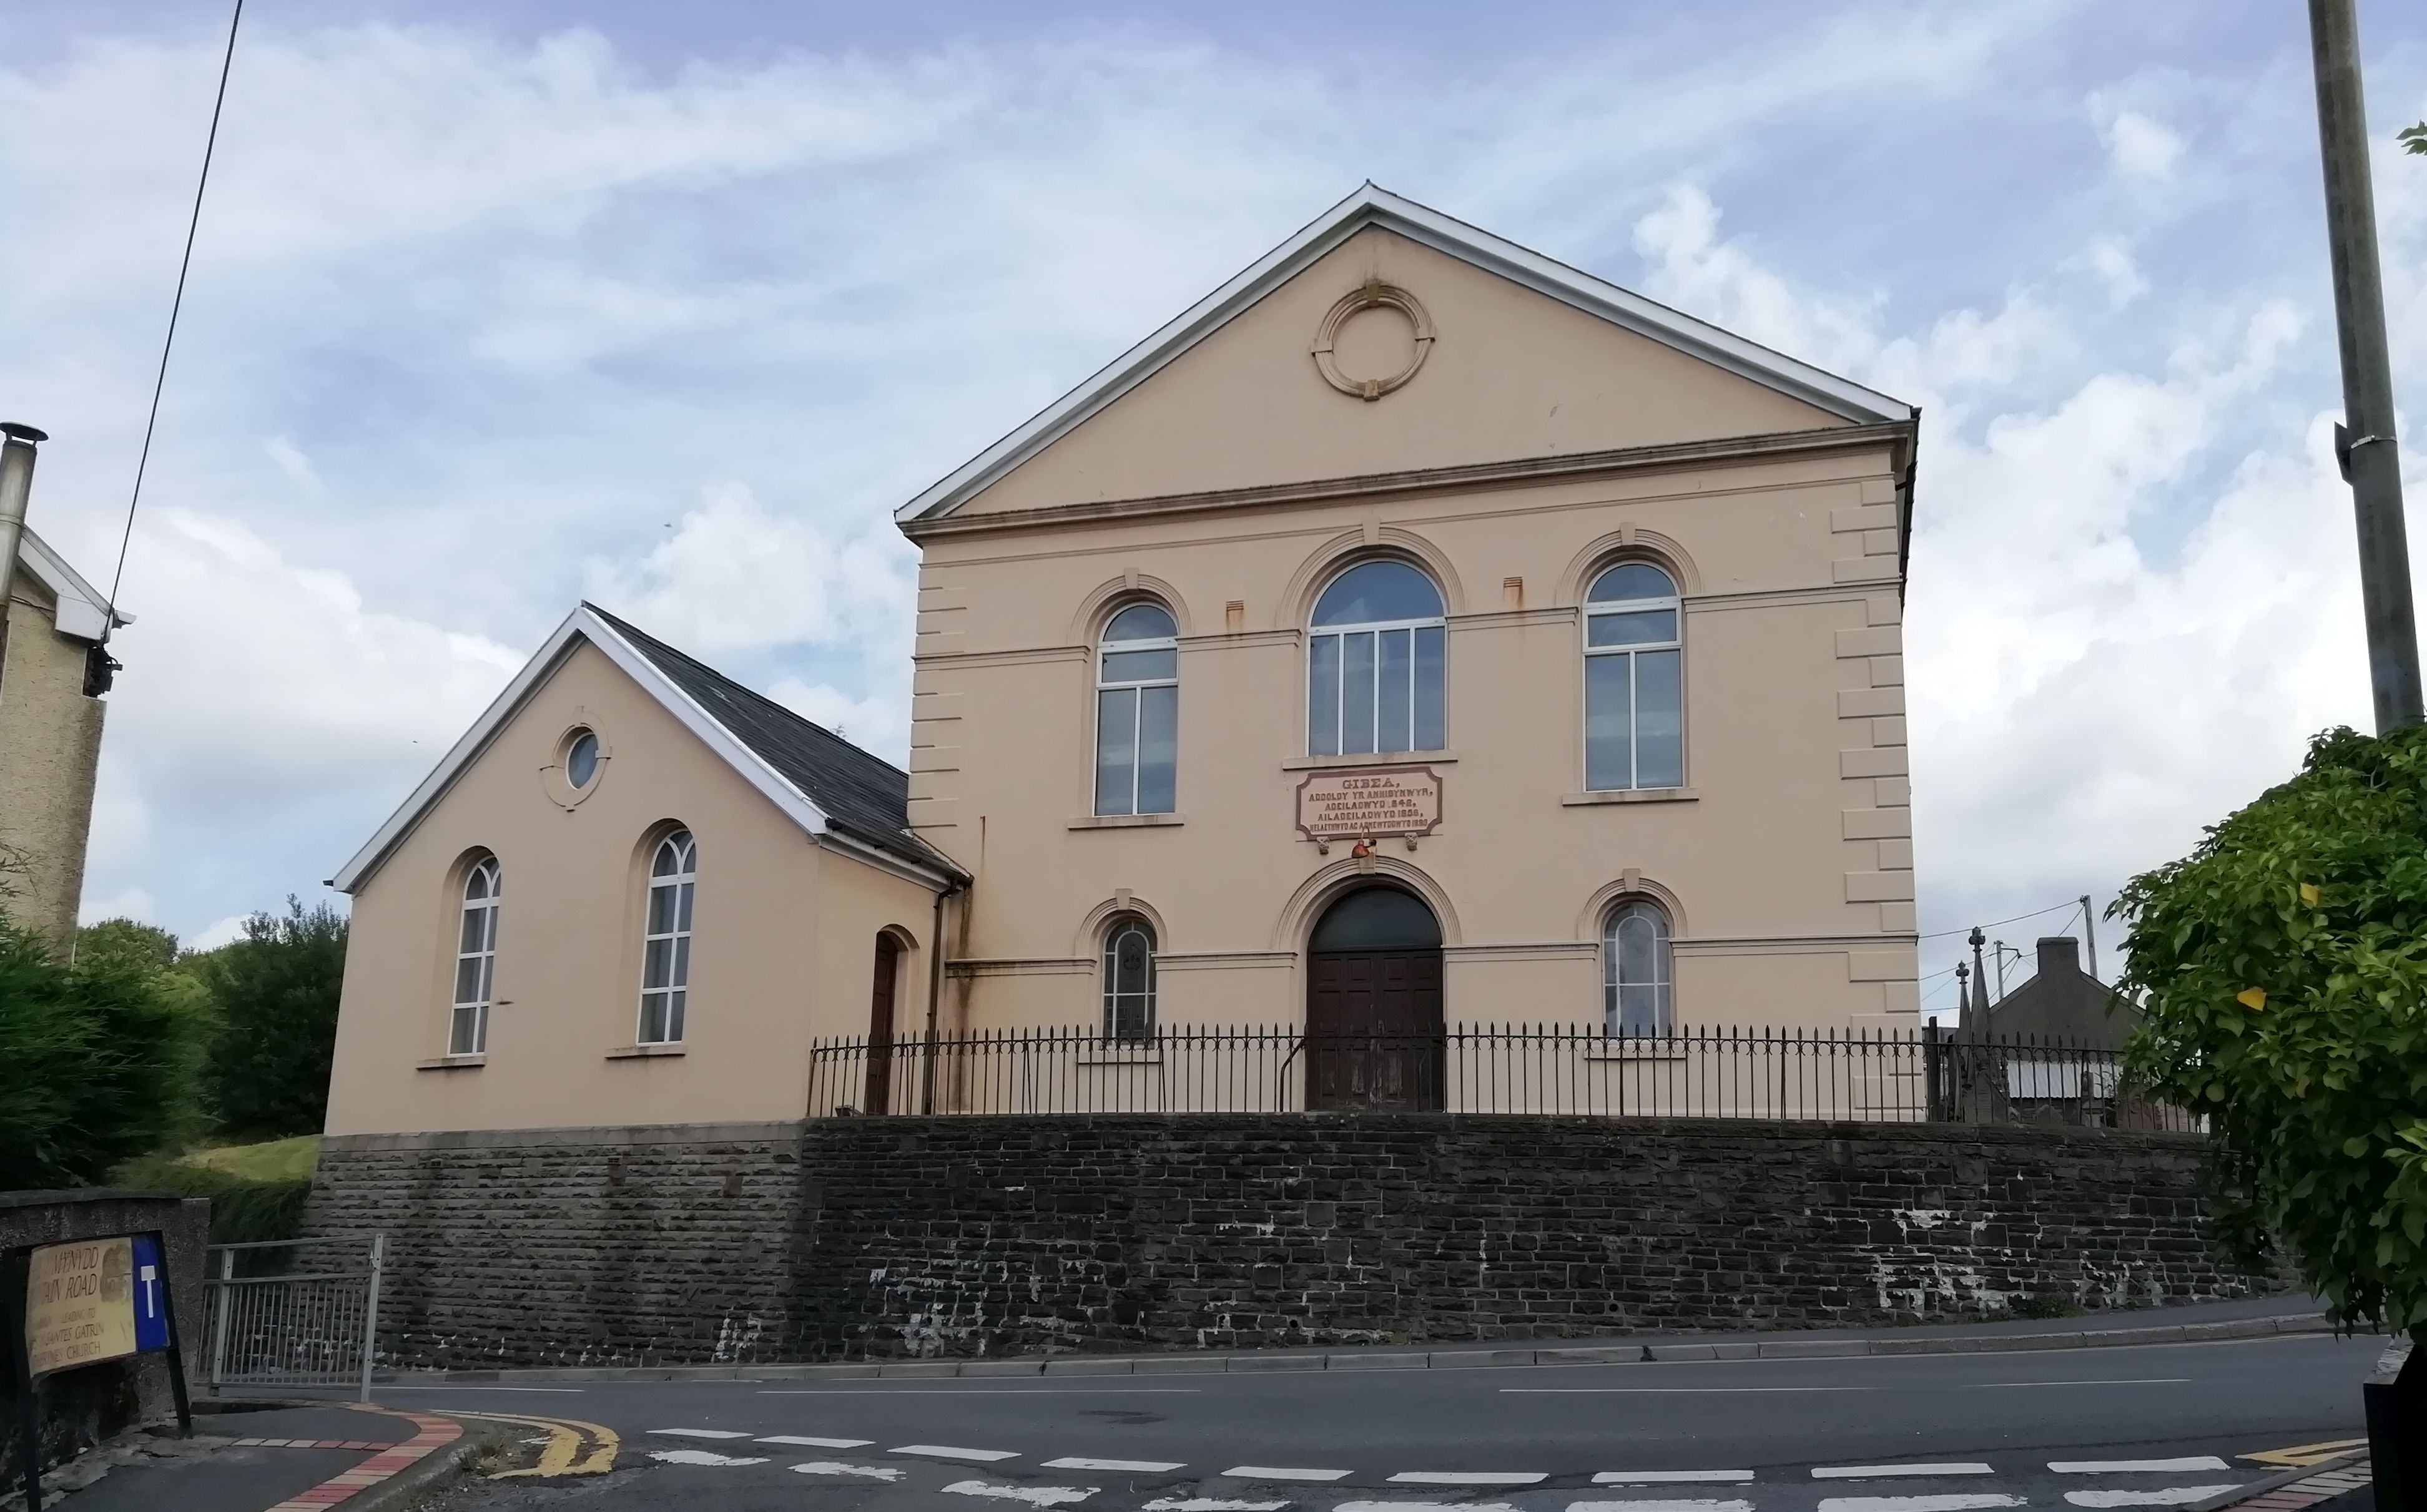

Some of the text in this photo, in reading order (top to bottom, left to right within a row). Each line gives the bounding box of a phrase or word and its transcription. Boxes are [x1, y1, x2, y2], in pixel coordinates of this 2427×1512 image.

[1342, 777, 1400, 789] GIBEA,
[1309, 792, 1349, 802] ADDOLDY
[1352, 791, 1365, 800] YR
[1388, 798, 1417, 808] 842,
[66, 1273, 97, 1299] ROAD
[66, 1341, 101, 1360] CHURCH
